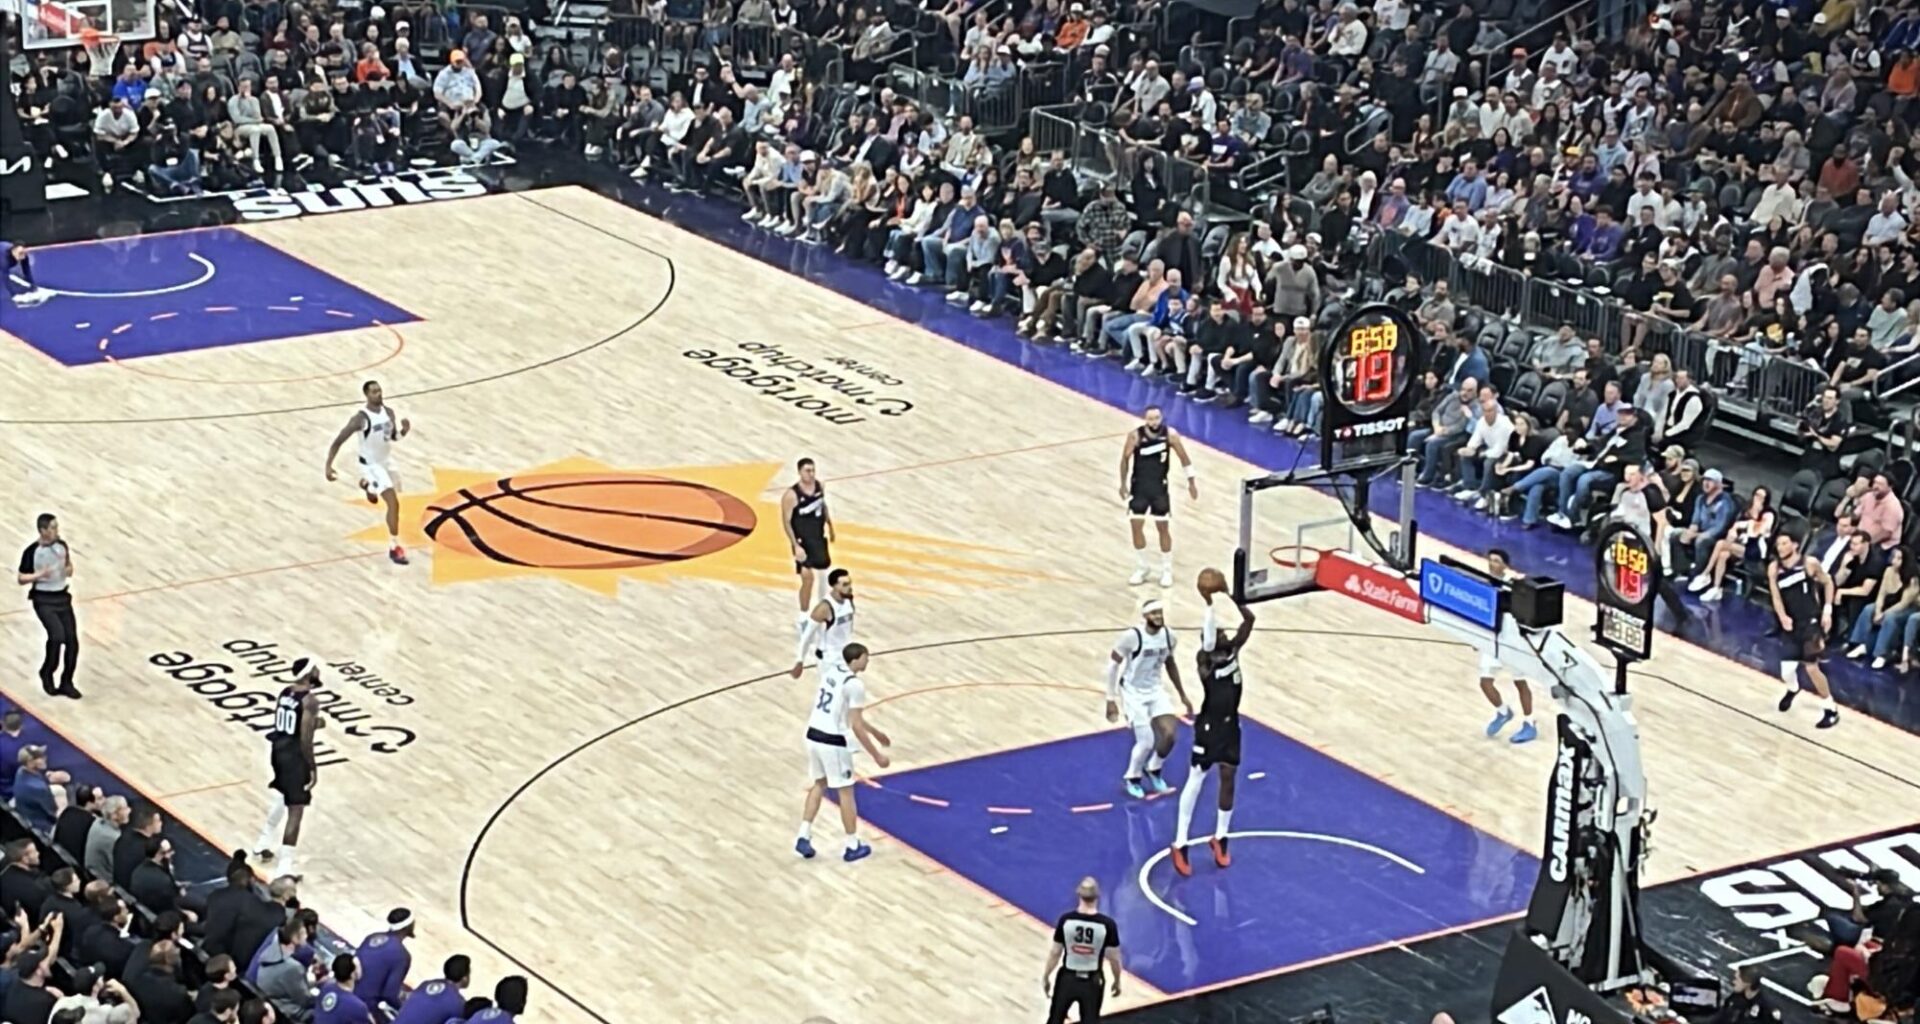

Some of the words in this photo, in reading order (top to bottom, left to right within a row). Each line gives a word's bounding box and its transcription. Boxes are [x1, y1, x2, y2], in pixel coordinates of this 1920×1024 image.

[1351, 323, 1398, 358] 8:58
[683, 349, 867, 425] mortgage
[823, 355, 904, 386] center
[1356, 353, 1392, 401] 19
[1353, 417, 1406, 437] TISSOT
[326, 661, 415, 706] center
[276, 706, 297, 735] 00
[1074, 925, 1094, 944] 39
